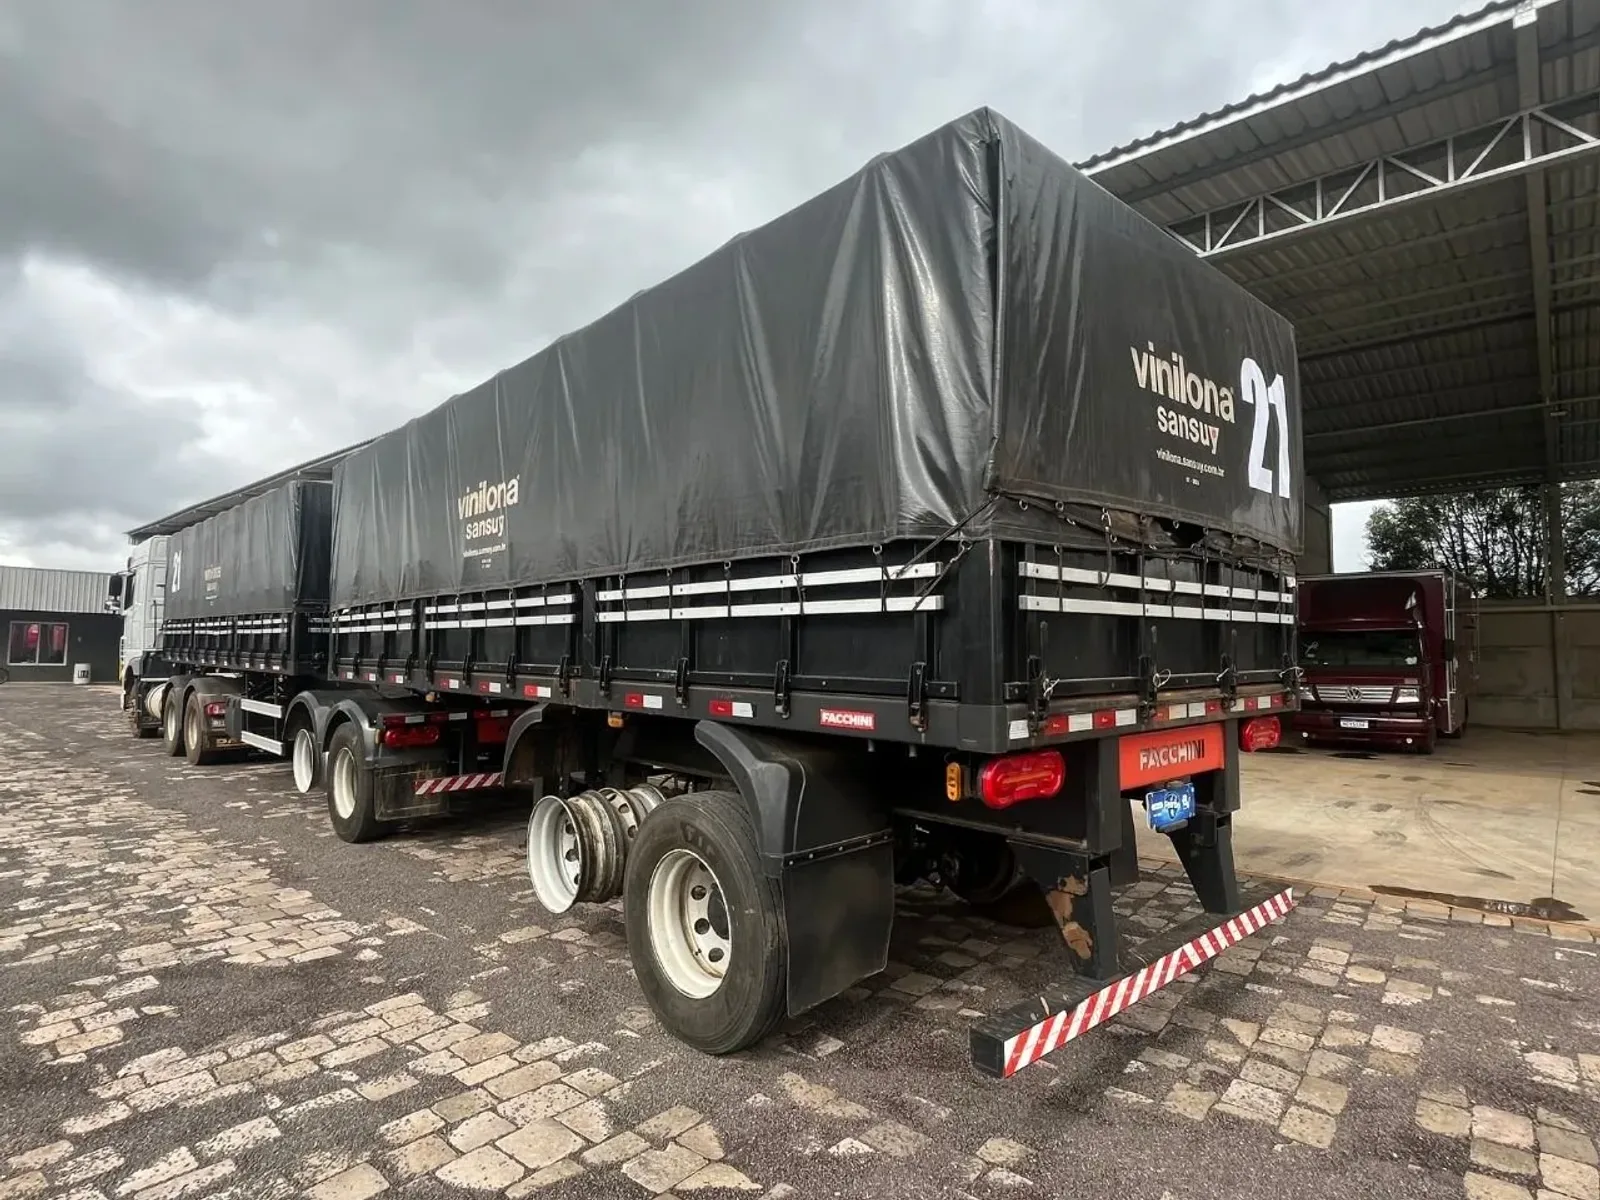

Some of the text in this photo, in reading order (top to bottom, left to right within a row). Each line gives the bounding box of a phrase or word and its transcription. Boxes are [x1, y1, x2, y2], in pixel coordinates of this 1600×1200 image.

[1130, 341, 1235, 423] vinilona
[1157, 405, 1220, 454] sansuy
[1241, 357, 1290, 499] 21
[458, 480, 519, 520] vinilona
[466, 515, 505, 539] sansuy
[822, 711, 873, 727] FACCHINI
[1140, 739, 1205, 771] FACCHINI
